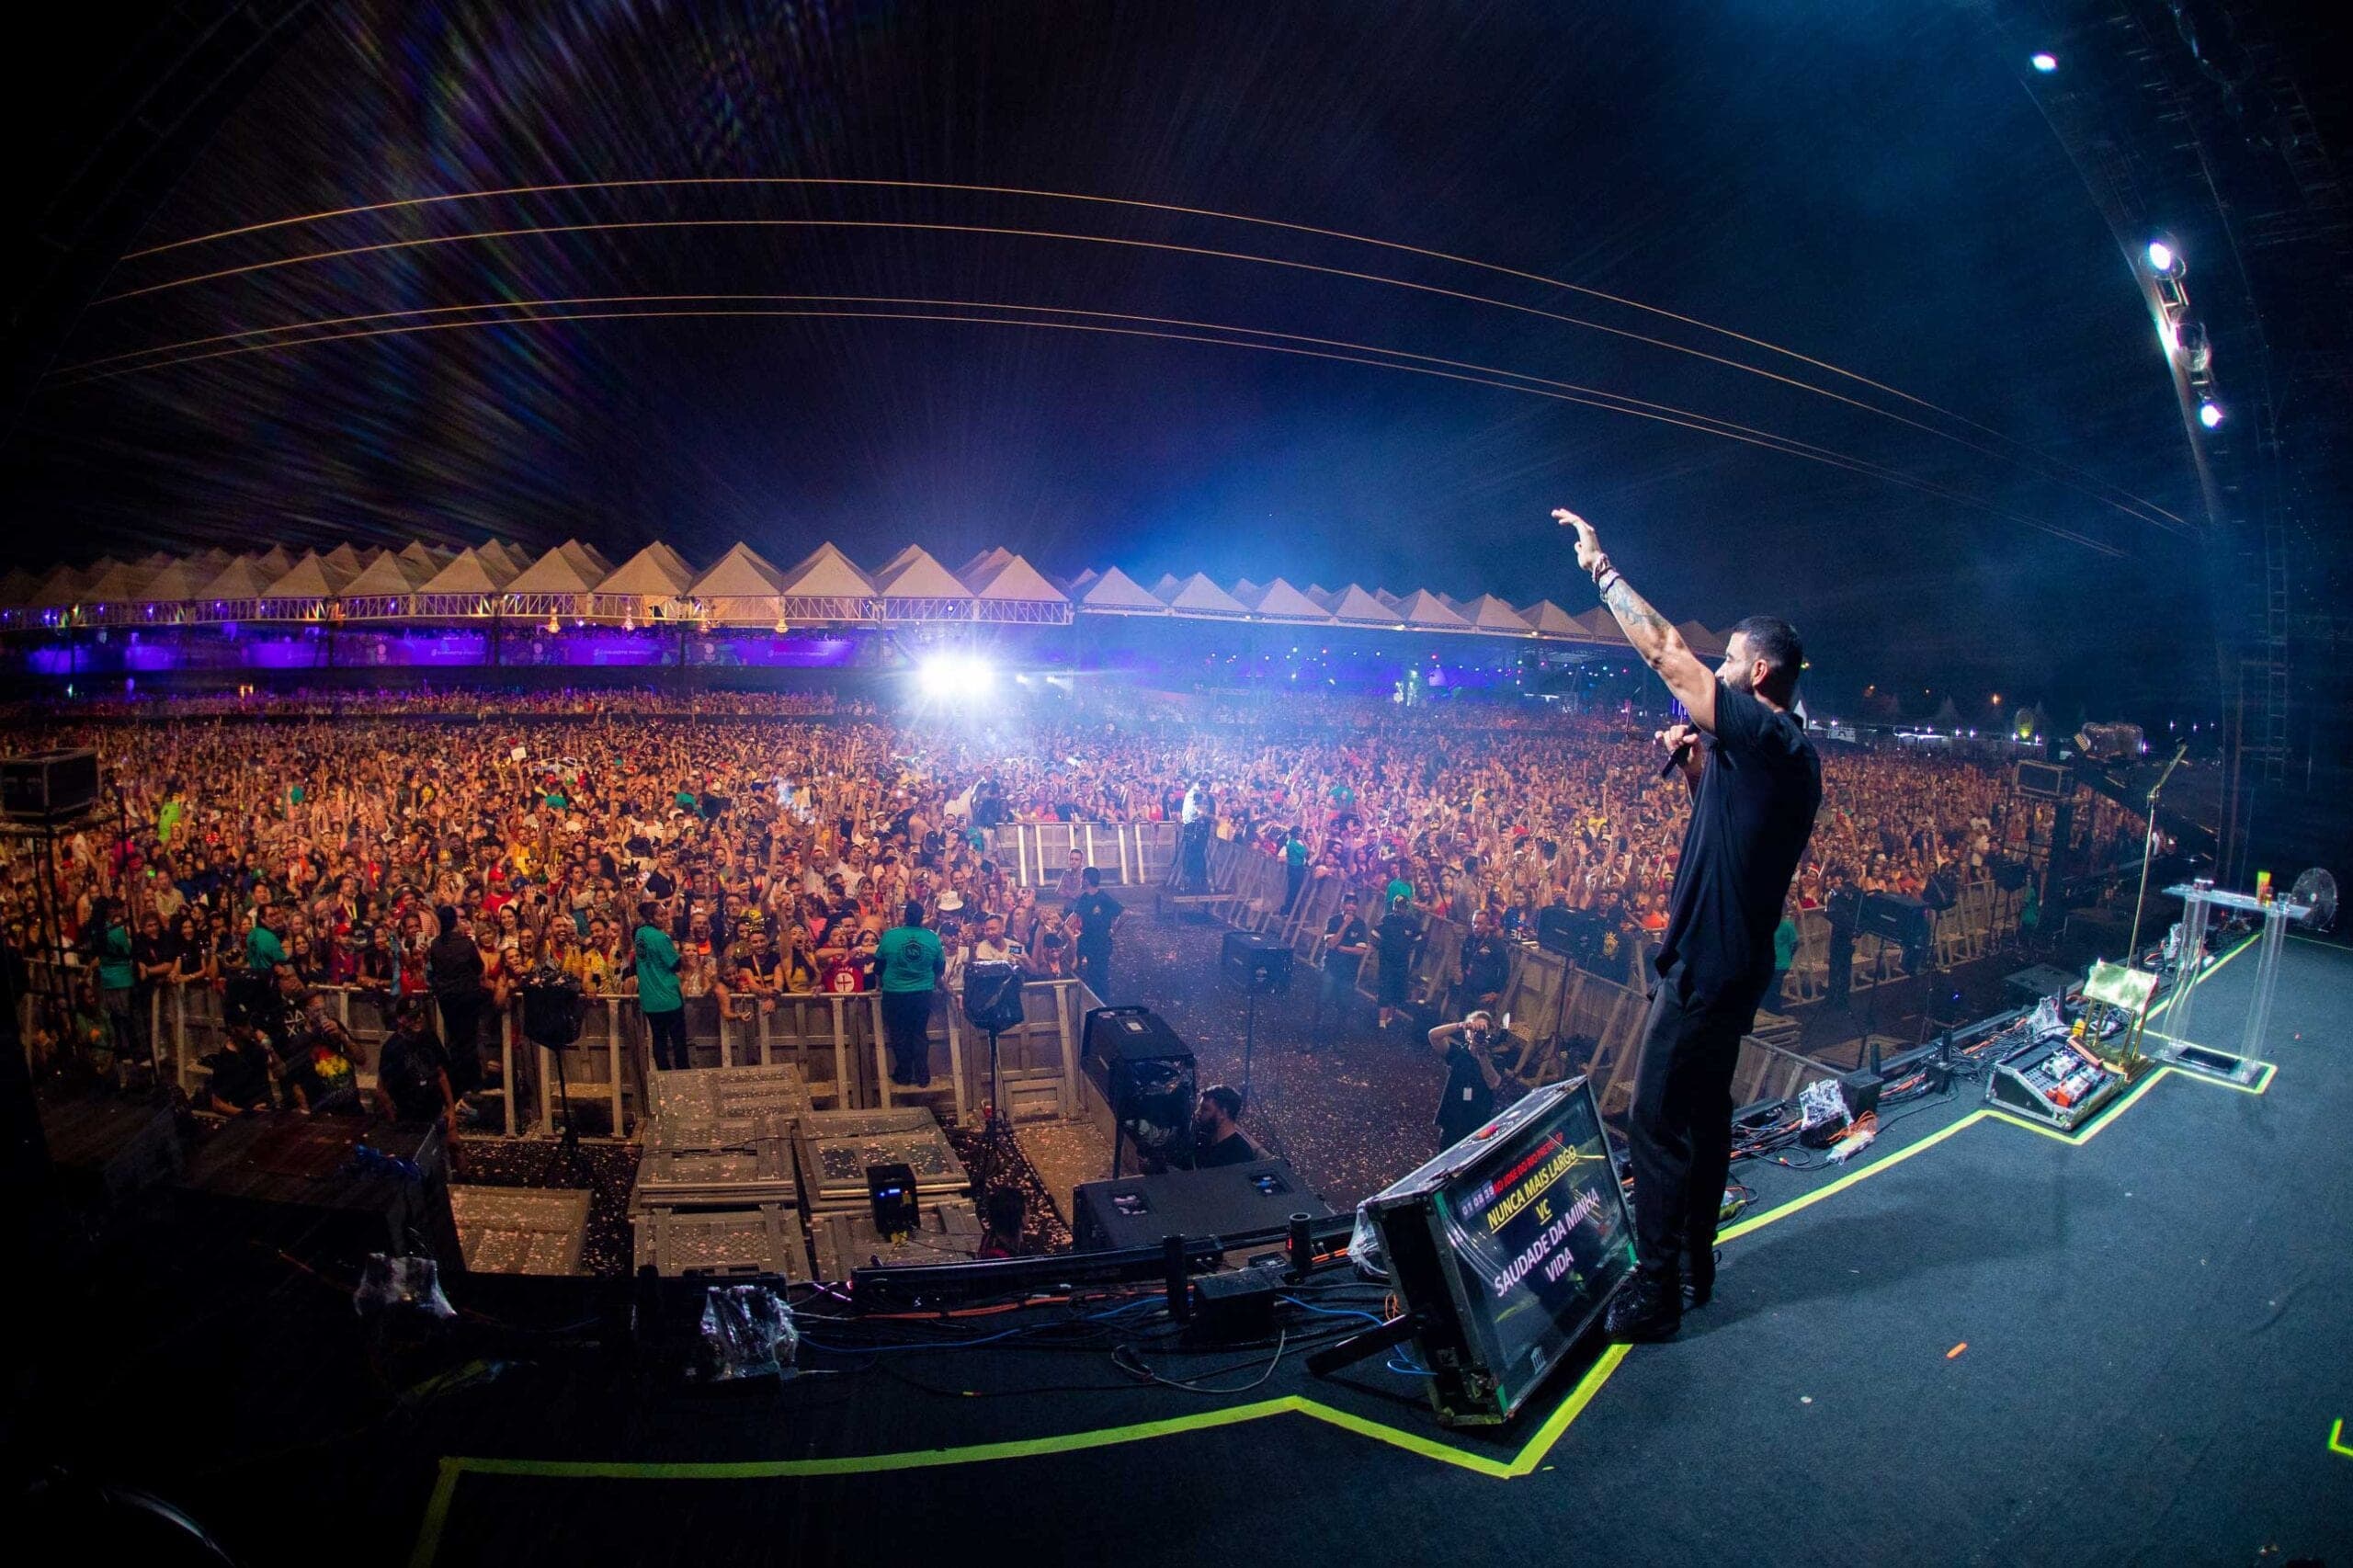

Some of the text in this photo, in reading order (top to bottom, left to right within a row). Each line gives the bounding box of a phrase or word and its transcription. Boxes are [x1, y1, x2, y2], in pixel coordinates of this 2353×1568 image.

[1487, 1145, 1576, 1229] NUNCA MAIS LARGO
[1536, 1199, 1552, 1221] VC
[1495, 1187, 1600, 1297] SAUDADE DA MINHA
[1545, 1246, 1574, 1282] VIDA
